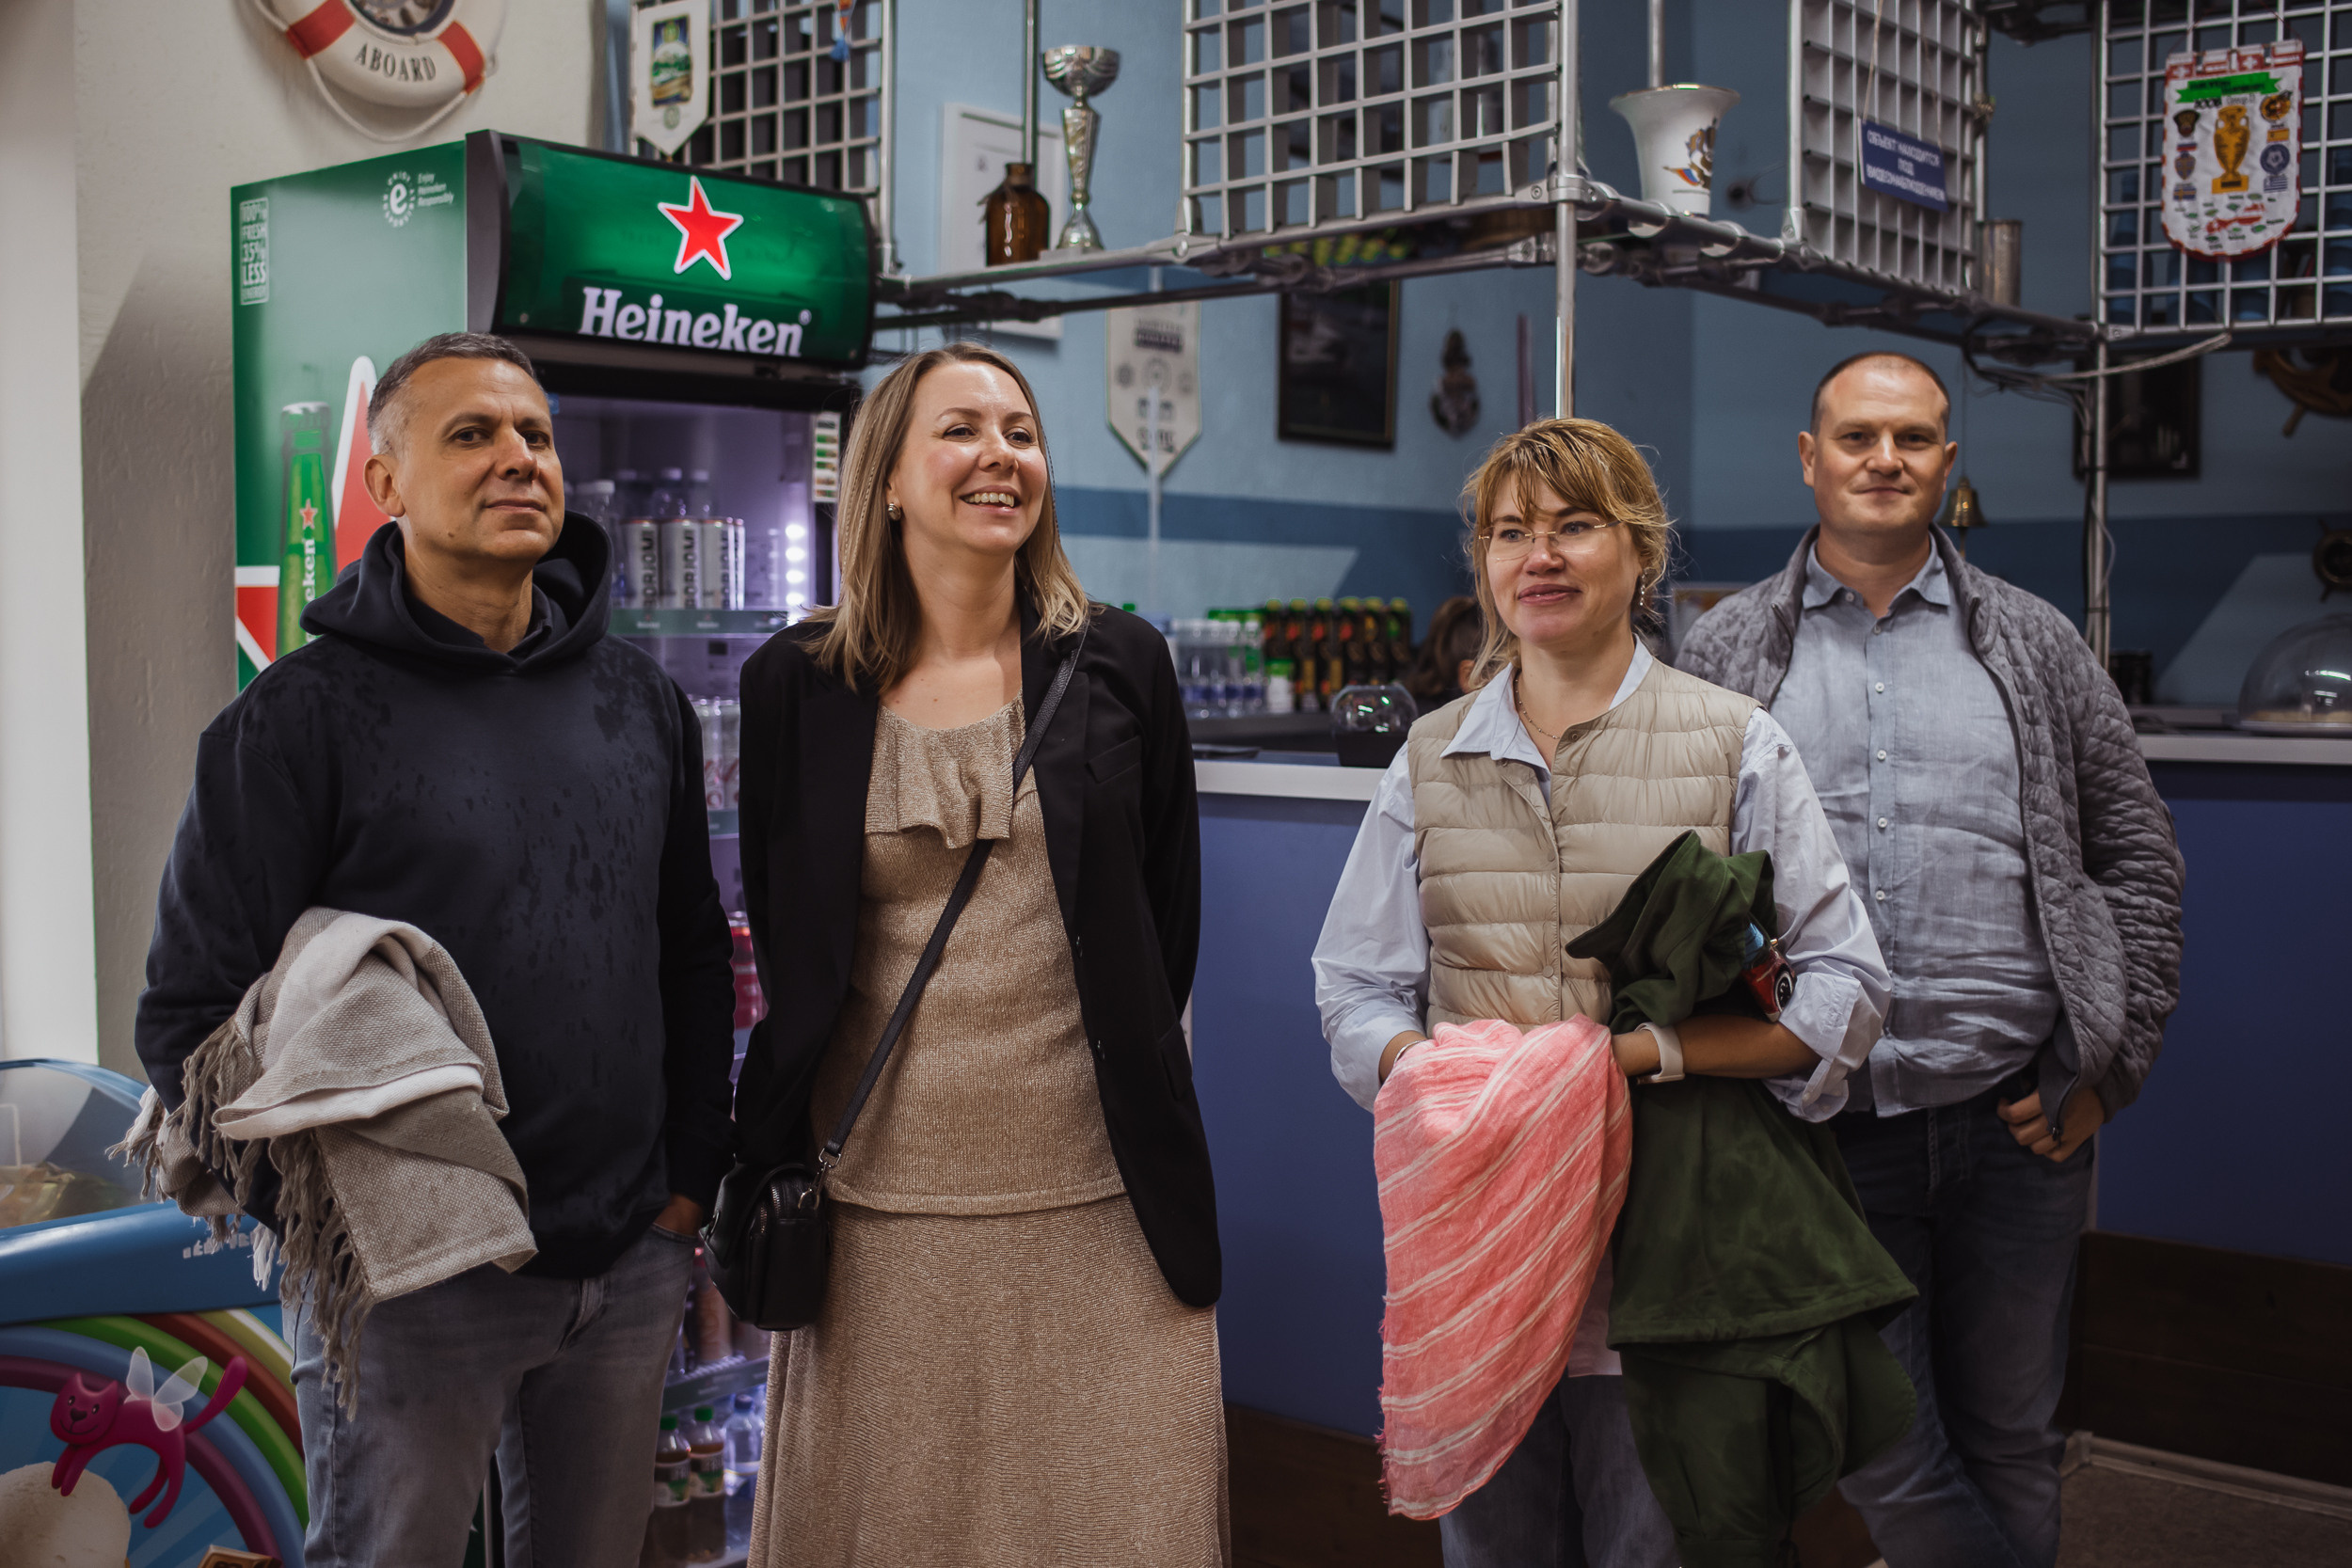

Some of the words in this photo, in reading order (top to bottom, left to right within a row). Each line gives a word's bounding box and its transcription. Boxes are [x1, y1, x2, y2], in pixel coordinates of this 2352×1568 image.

[355, 43, 437, 83] ABOARD
[243, 262, 266, 286] LESS
[578, 286, 803, 357] Heineken
